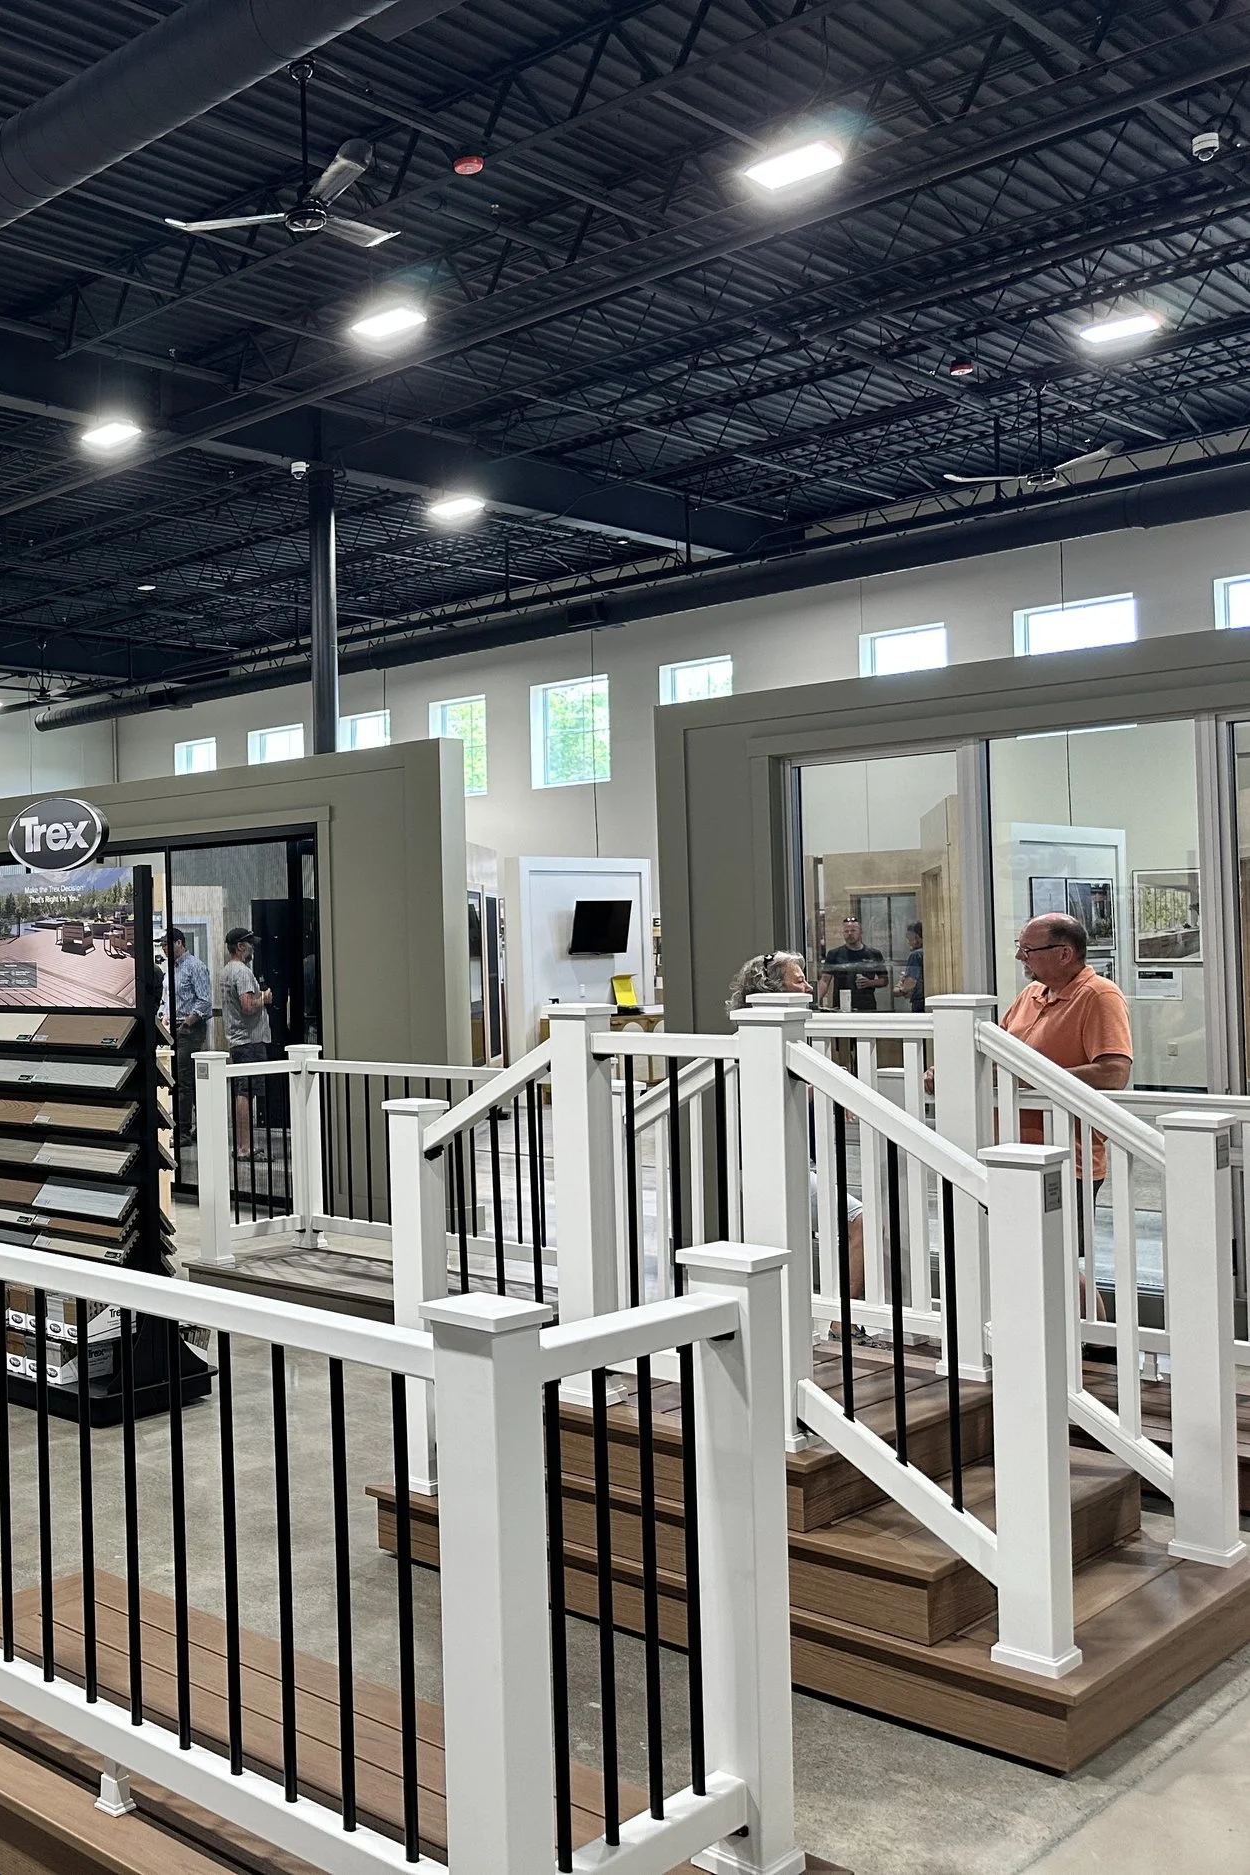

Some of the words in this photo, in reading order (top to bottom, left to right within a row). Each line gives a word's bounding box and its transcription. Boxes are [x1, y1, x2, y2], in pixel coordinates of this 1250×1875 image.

[19, 816, 90, 853] Trex
[45, 895, 60, 904] Right
[60, 894, 68, 902] for
[109, 1309, 121, 1318] Tre
